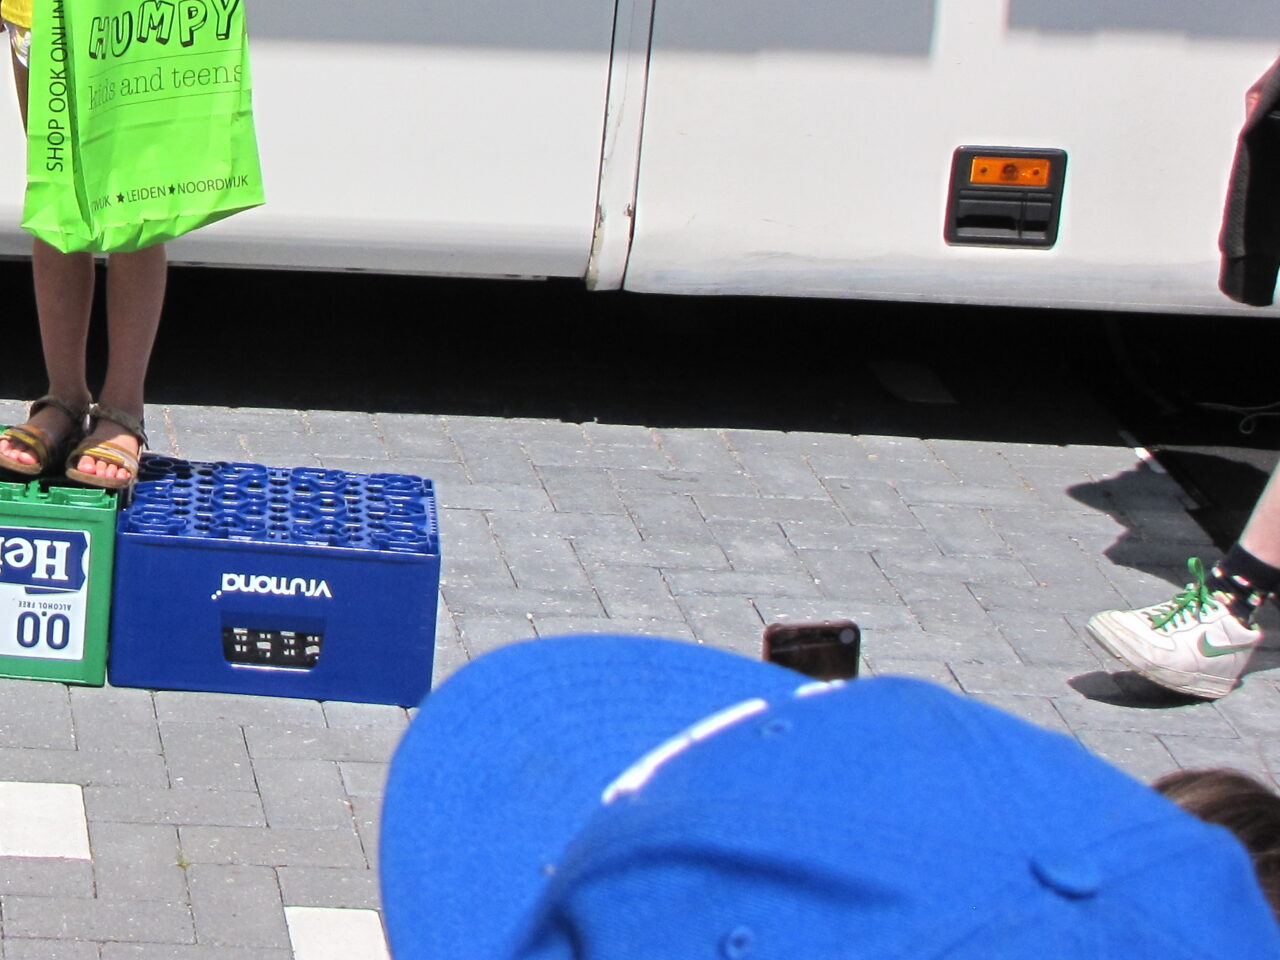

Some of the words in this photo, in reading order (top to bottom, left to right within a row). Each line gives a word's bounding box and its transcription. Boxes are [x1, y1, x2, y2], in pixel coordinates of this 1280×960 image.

[48, 67, 68, 113] OOK
[88, 78, 116, 111] kids
[120, 66, 165, 97] and
[172, 63, 243, 89] teens
[46, 118, 66, 172] SHOP
[126, 185, 167, 203] LEIDEN
[177, 175, 249, 195] NOORDWIJK
[221, 572, 333, 598] vrumona
[18, 600, 36, 609] FREE
[38, 601, 72, 612] ALCOHOL
[16, 611, 71, 651] 0.0
